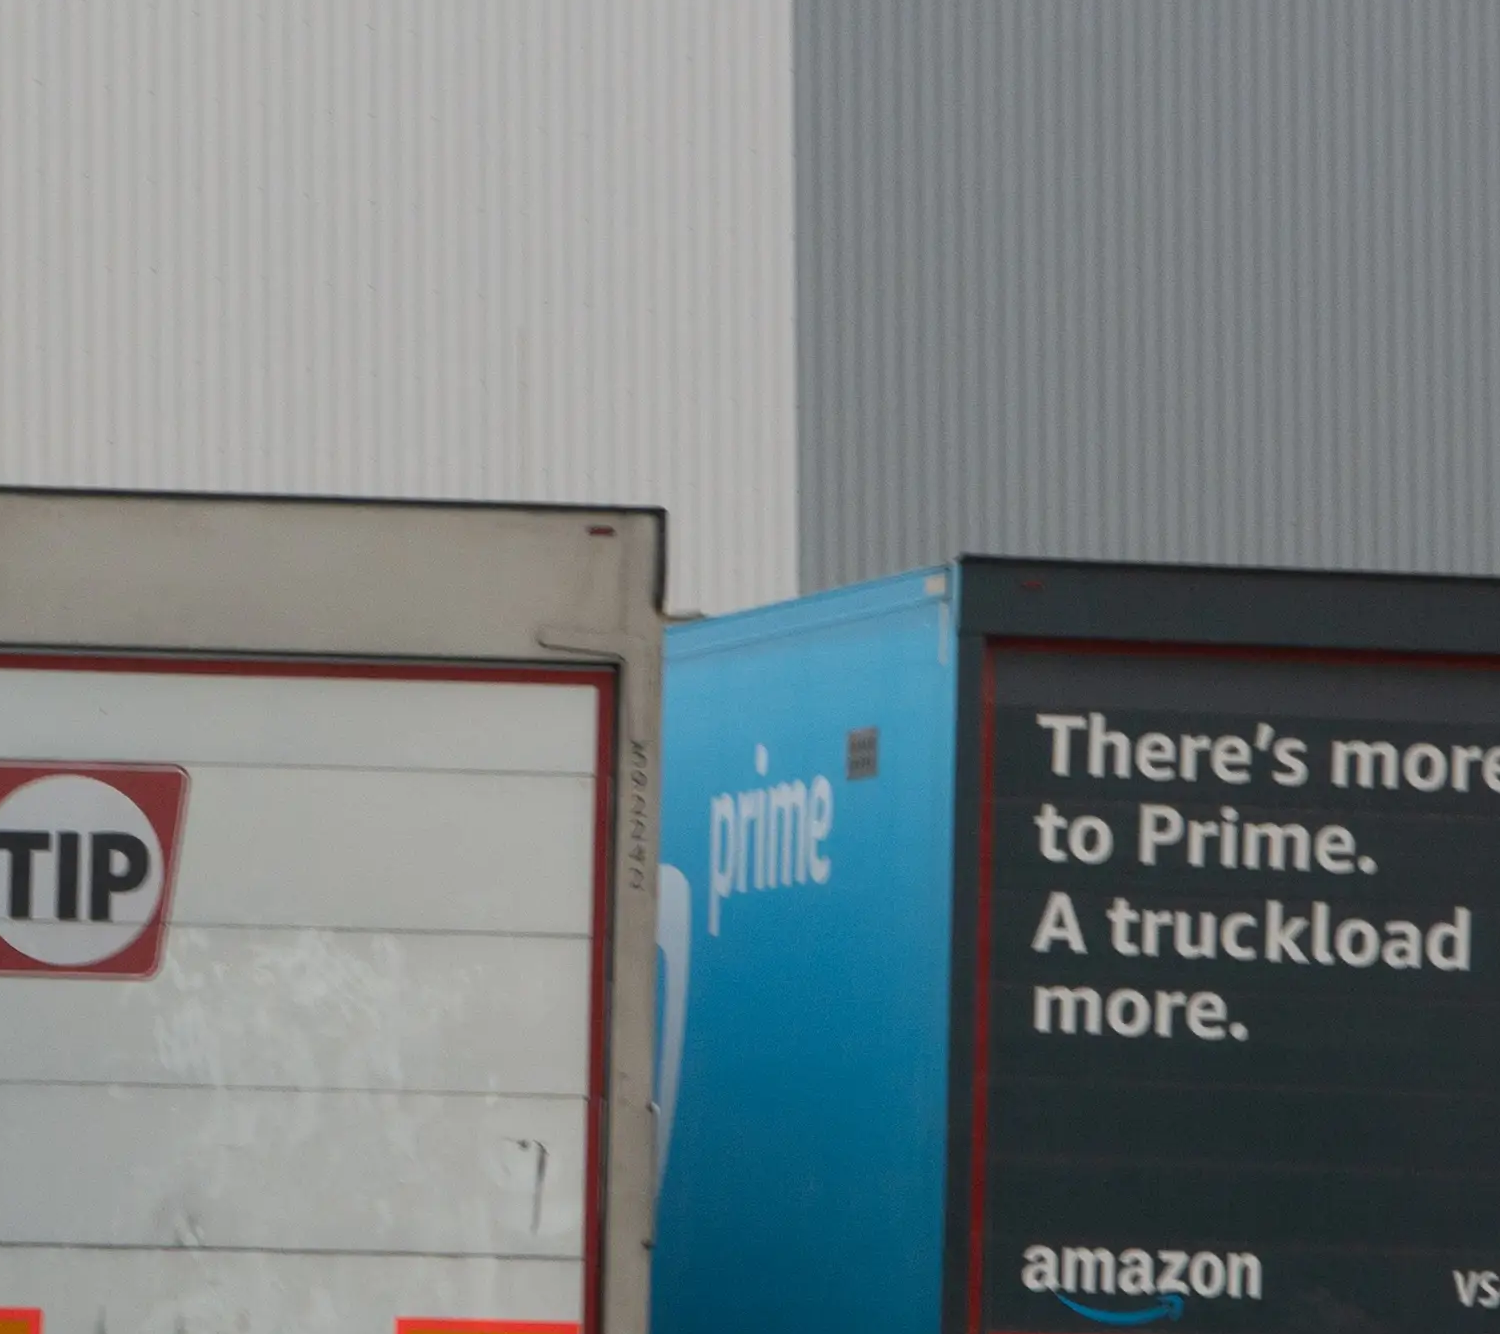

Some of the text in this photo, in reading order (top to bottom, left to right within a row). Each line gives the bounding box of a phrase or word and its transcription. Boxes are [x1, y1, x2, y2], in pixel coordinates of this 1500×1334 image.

[1036, 711, 1308, 787] There's
[709, 741, 834, 937] prime
[1034, 803, 1378, 875] to Prime.
[1032, 891, 1472, 971] A truckload
[1033, 985, 1249, 1041] more.
[1021, 1244, 1262, 1300] amazon
